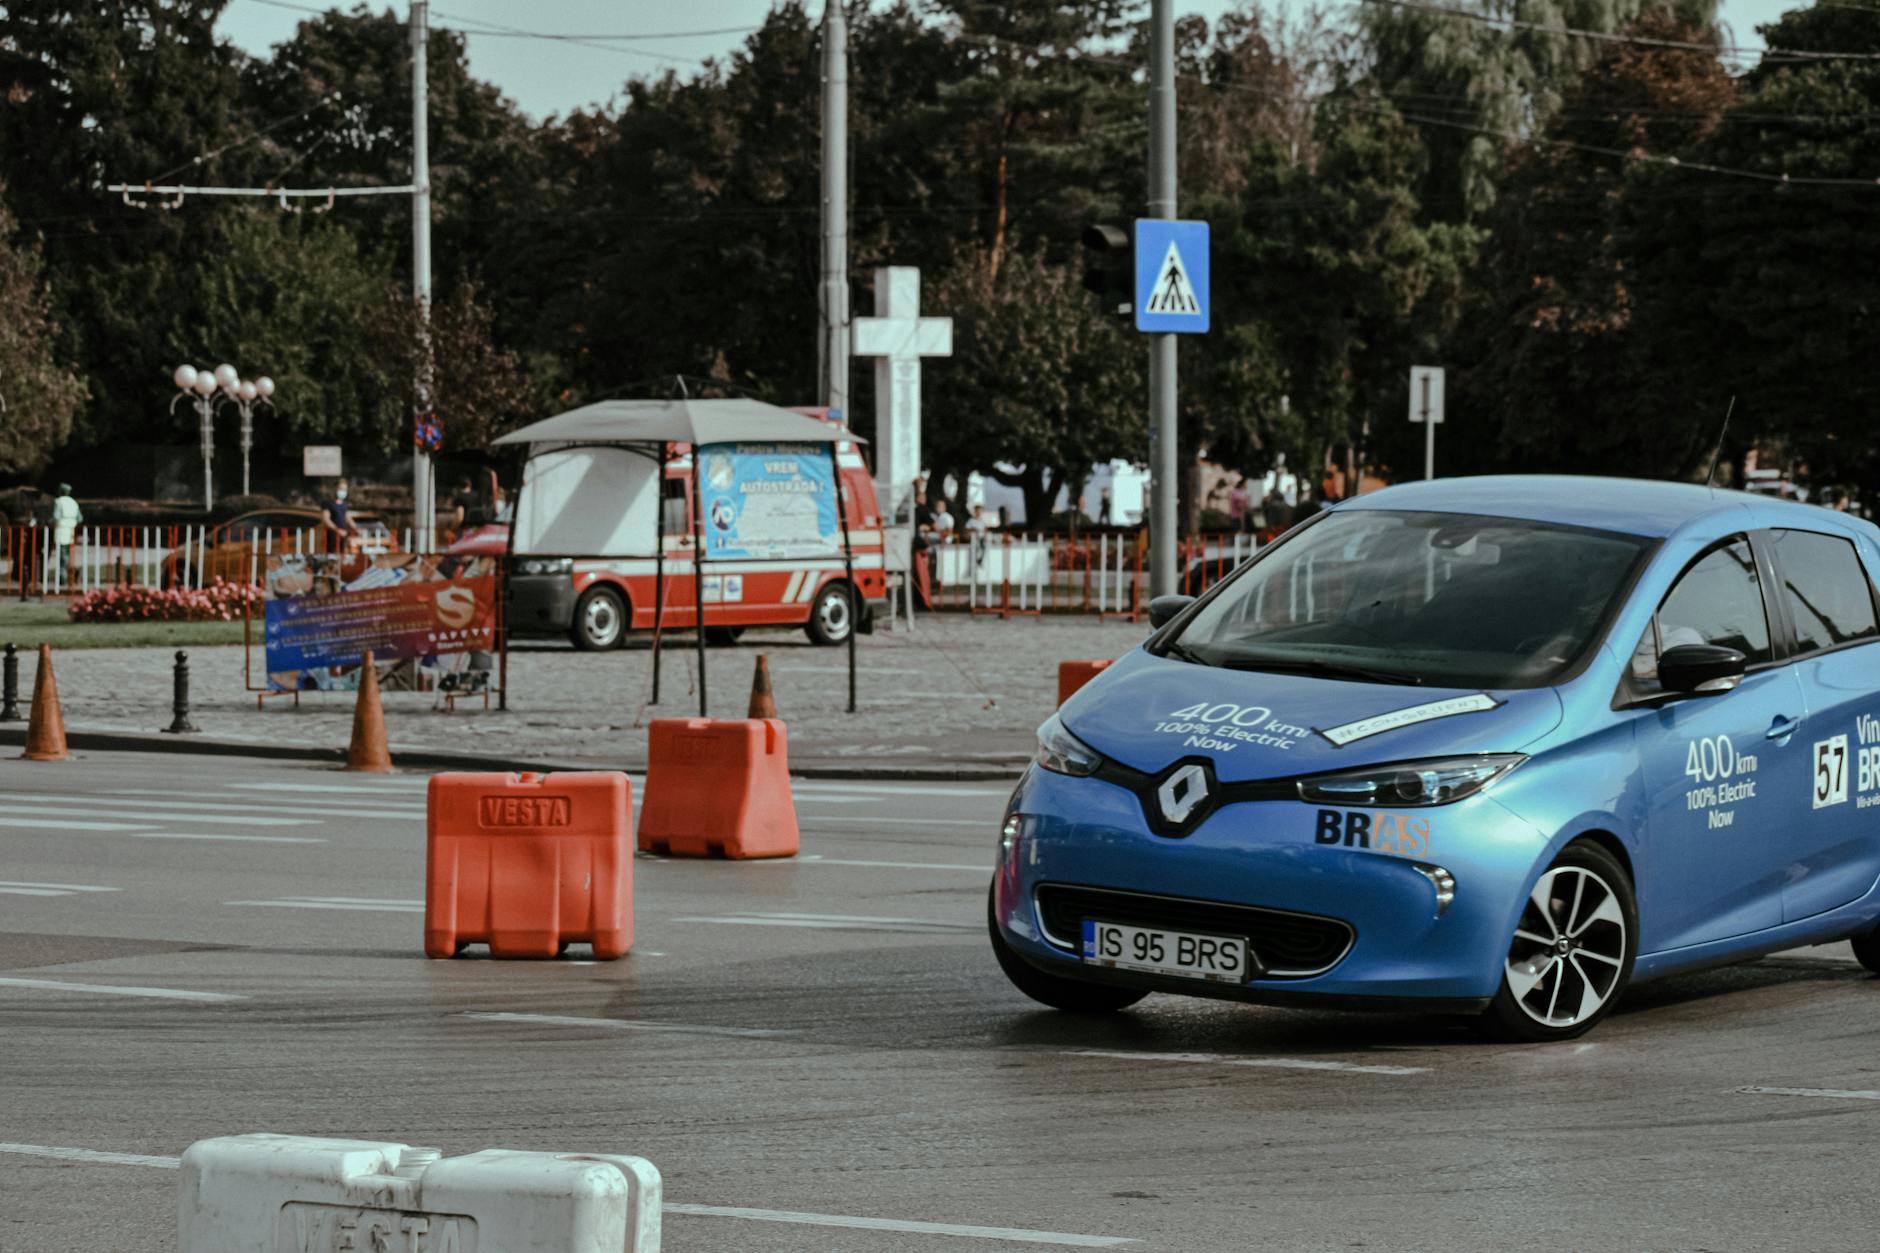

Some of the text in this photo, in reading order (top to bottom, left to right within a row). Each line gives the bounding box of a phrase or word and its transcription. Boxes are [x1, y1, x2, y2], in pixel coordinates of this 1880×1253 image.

[764, 461, 798, 474] VREM
[1169, 702, 1271, 727] 400
[1154, 722, 1295, 749] 100% Electric
[1183, 735, 1237, 751] Now
[1685, 734, 1734, 783] 400
[1817, 744, 1844, 802] 57
[1686, 778, 1756, 811] 100% Electric
[486, 798, 567, 826] VESTA
[1708, 810, 1734, 830] Now
[1315, 809, 1429, 858] BRAS
[1099, 927, 1123, 957] IS
[1134, 932, 1164, 962] 95
[1178, 936, 1239, 971] BRS
